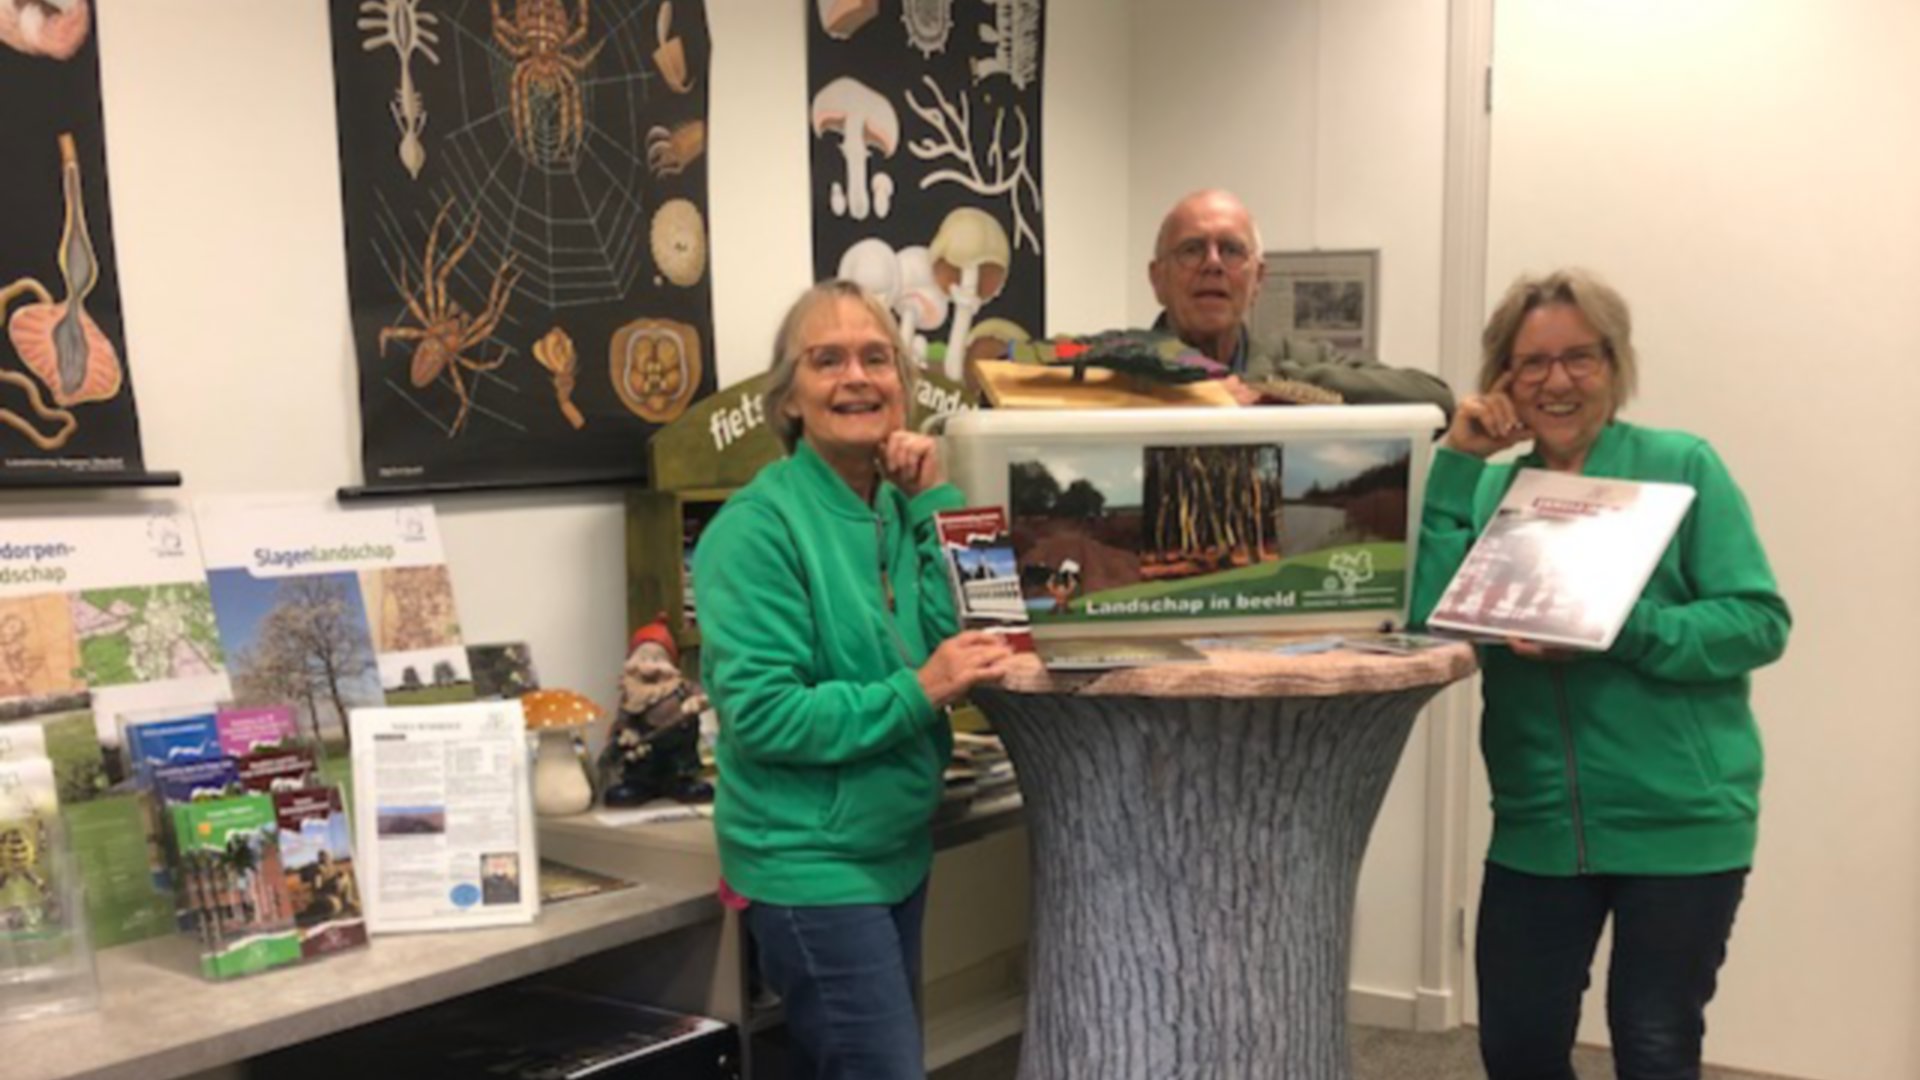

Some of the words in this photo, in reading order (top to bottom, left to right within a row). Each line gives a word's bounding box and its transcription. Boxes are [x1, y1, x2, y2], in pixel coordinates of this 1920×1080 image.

[253, 544, 395, 568] Slagenlandschap
[1086, 598, 1204, 614] Landschap
[1210, 592, 1230, 609] in
[1235, 591, 1296, 609] beeld
